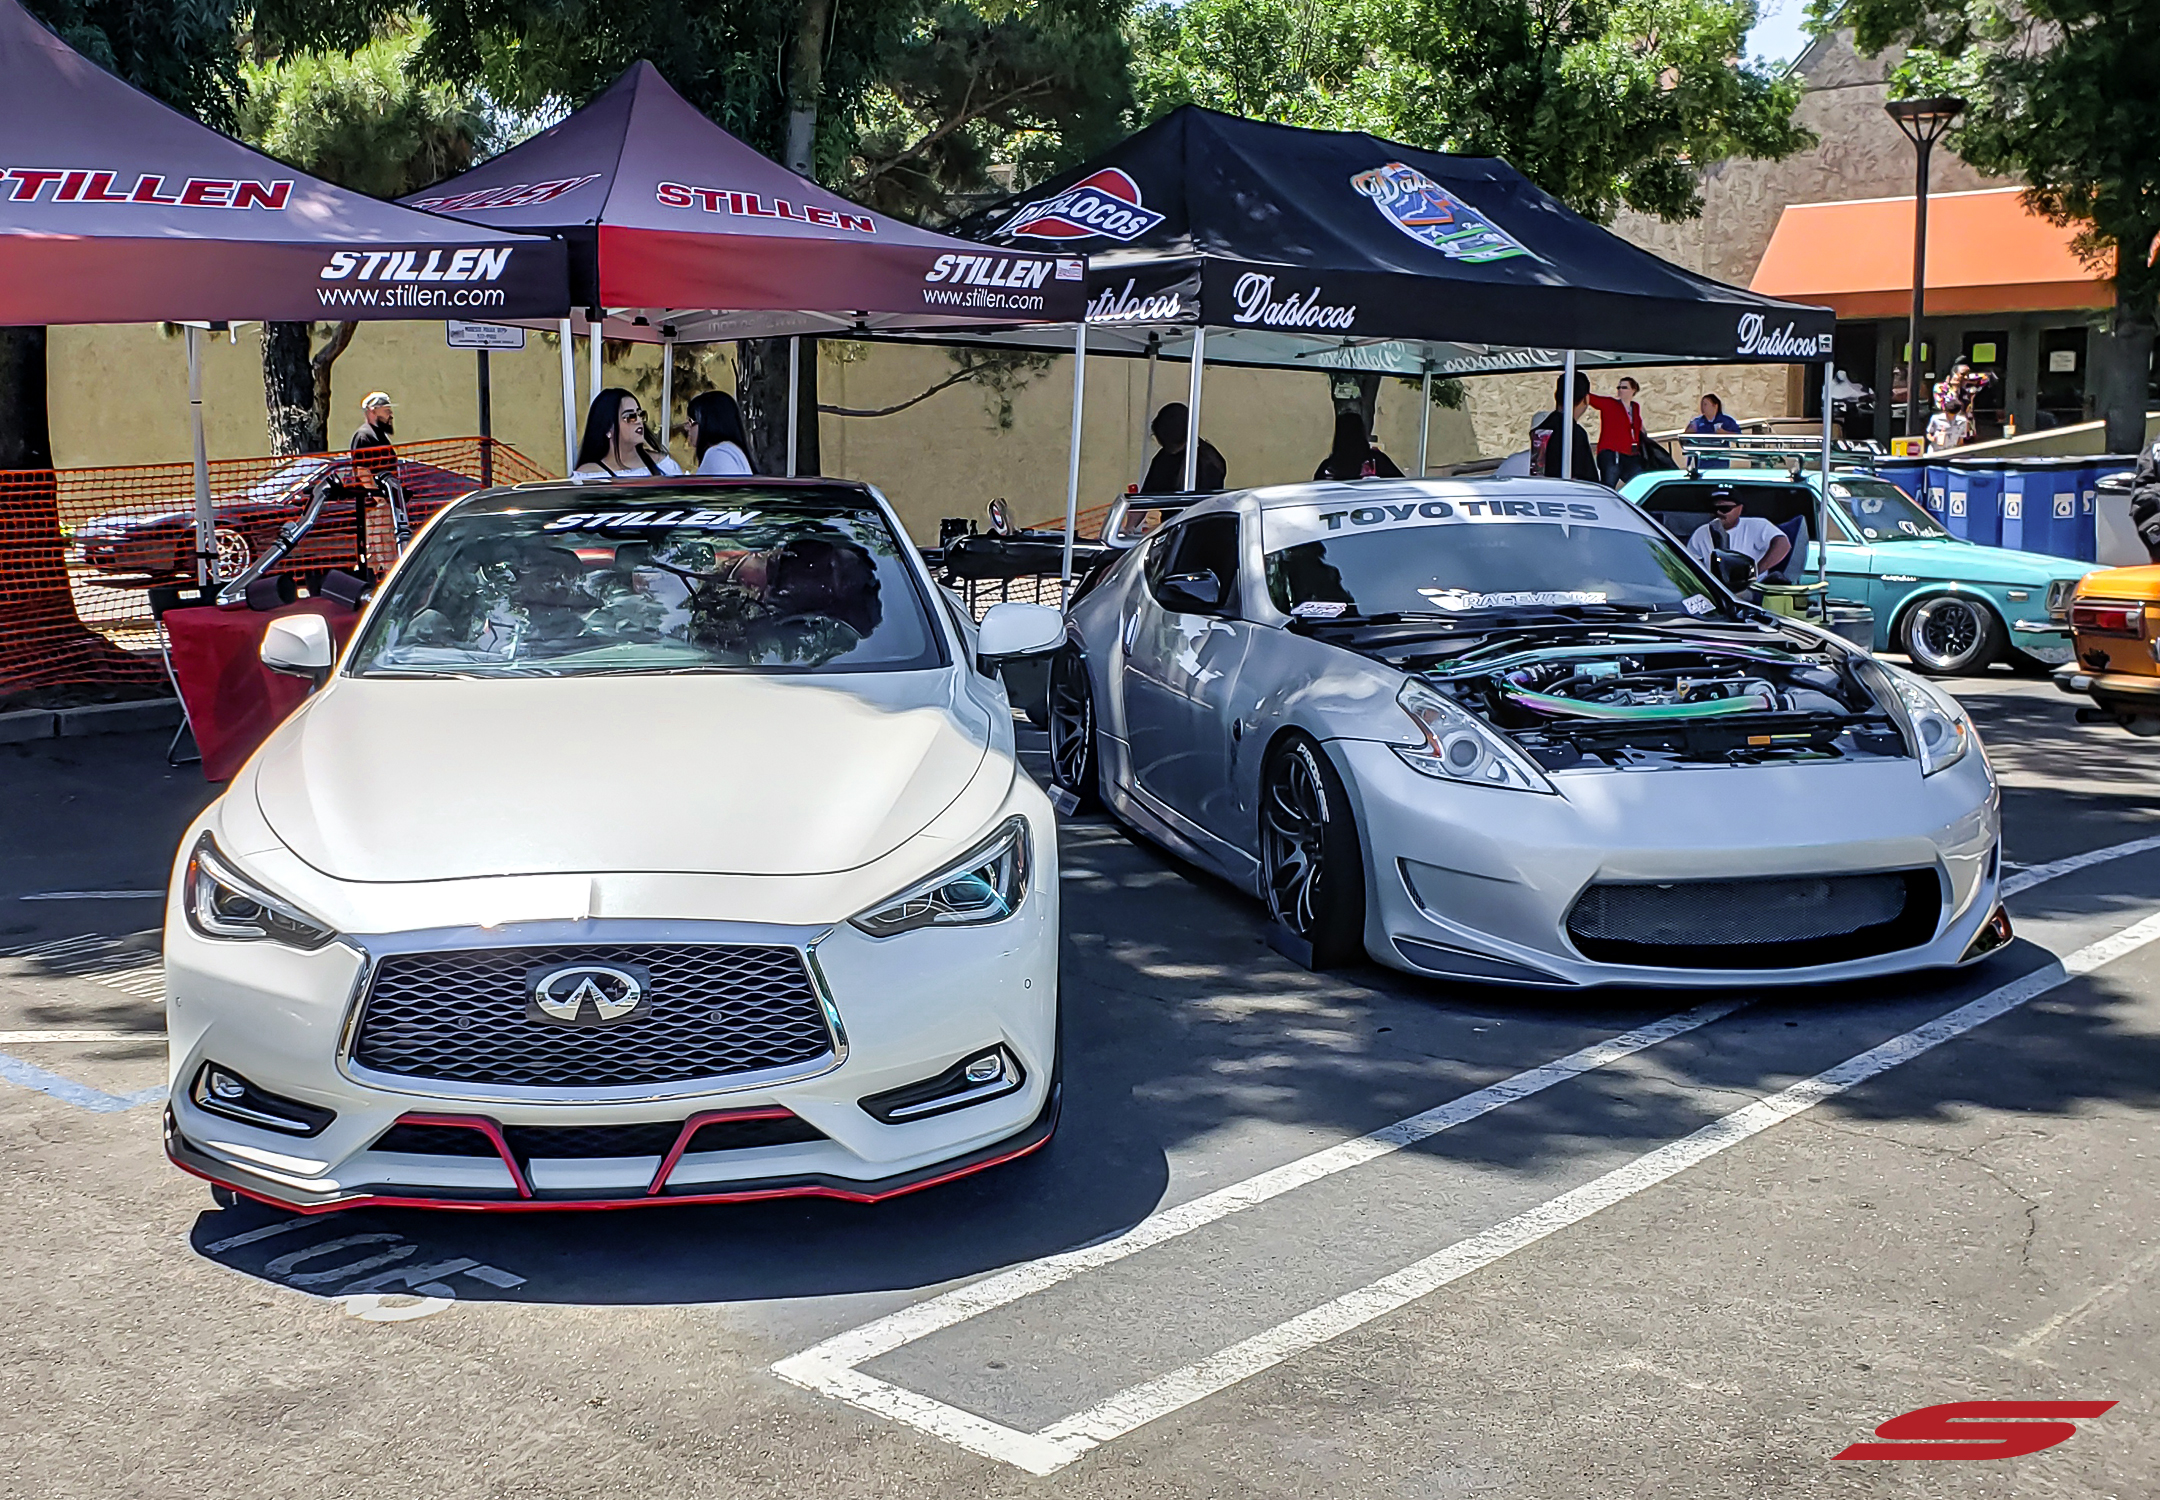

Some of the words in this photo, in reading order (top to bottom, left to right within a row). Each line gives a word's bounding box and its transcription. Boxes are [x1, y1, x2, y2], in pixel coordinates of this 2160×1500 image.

[0, 167, 295, 210] TILLEN
[656, 180, 878, 235] STILLEN
[320, 246, 513, 282] STILLEN
[924, 253, 1054, 290] STILLEN
[316, 284, 505, 308] www.stillen.com
[922, 288, 1044, 311] www.stillen.com
[1085, 278, 1181, 323] atslocos
[1232, 271, 1356, 330] Datslocos
[1736, 311, 1818, 358] Datslocos
[543, 510, 762, 530] STILLEN
[1318, 501, 1454, 531] TOYO
[1459, 500, 1599, 521] TIRES
